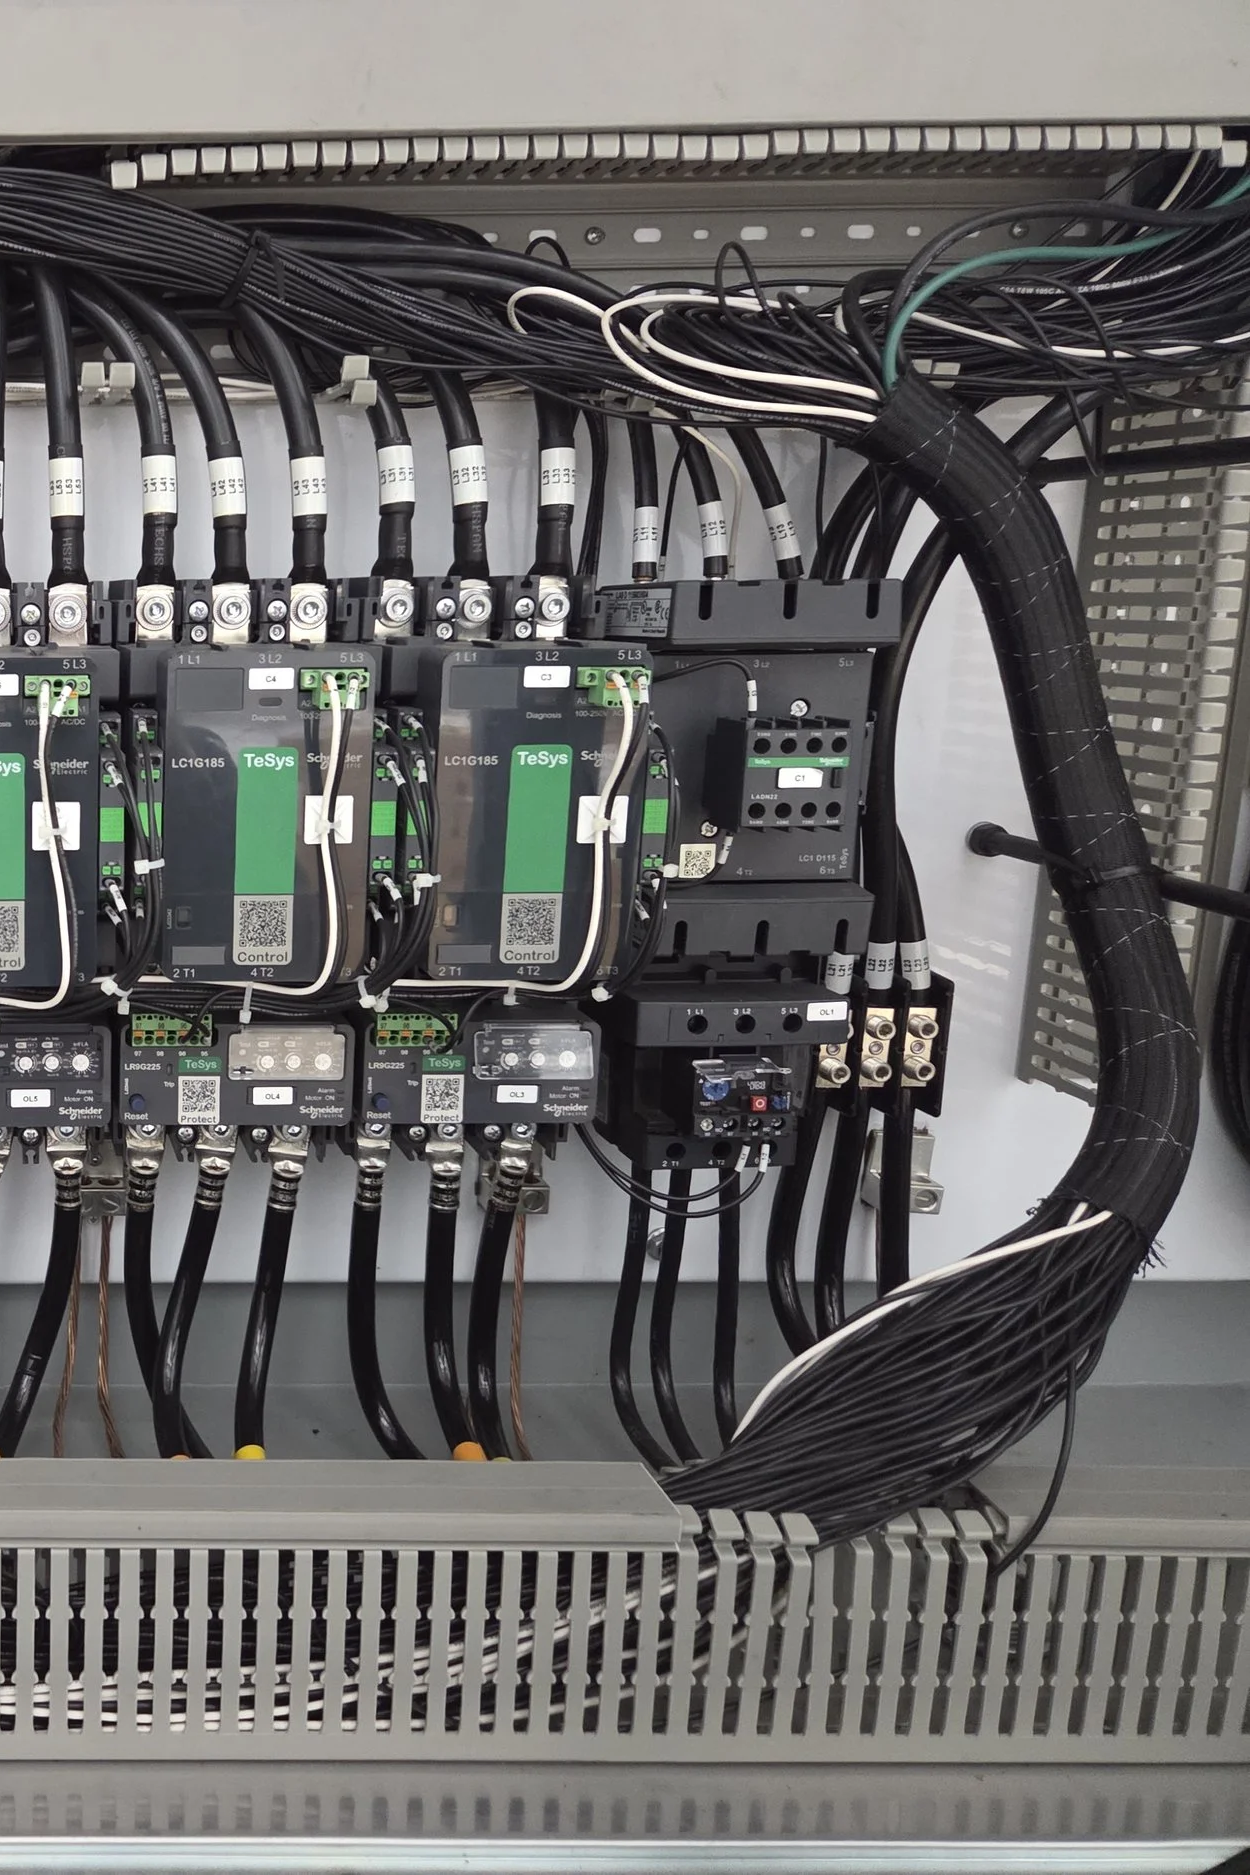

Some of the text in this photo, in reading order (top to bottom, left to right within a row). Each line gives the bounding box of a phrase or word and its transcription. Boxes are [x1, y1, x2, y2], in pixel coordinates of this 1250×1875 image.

[388, 468, 396, 482] L31
[472, 466, 480, 481] L32
[552, 468, 561, 483] L33
[312, 478, 320, 493] L43
[640, 527, 649, 540] L11
[709, 520, 717, 536] L12
[777, 524, 786, 540] L13
[252, 714, 286, 722] Diagnosis
[526, 712, 562, 720] Diagnosis
[172, 758, 225, 768] LC1G185
[244, 754, 294, 770] TeSys
[445, 756, 498, 766] LC1G185
[517, 752, 568, 768] TeSys
[816, 854, 836, 862] D115
[840, 848, 848, 869] TeSys
[238, 952, 287, 963] Control
[505, 950, 555, 961] Control
[828, 964, 836, 976] L21
[868, 959, 876, 971] L22
[904, 959, 912, 972] L23
[914, 959, 922, 972] L23
[185, 1060, 217, 1069] TeSys
[429, 1058, 461, 1068] TeSys
[59, 1108, 103, 1116] Schneider
[300, 1106, 344, 1114] Schneider
[543, 1104, 588, 1112] Schneider
